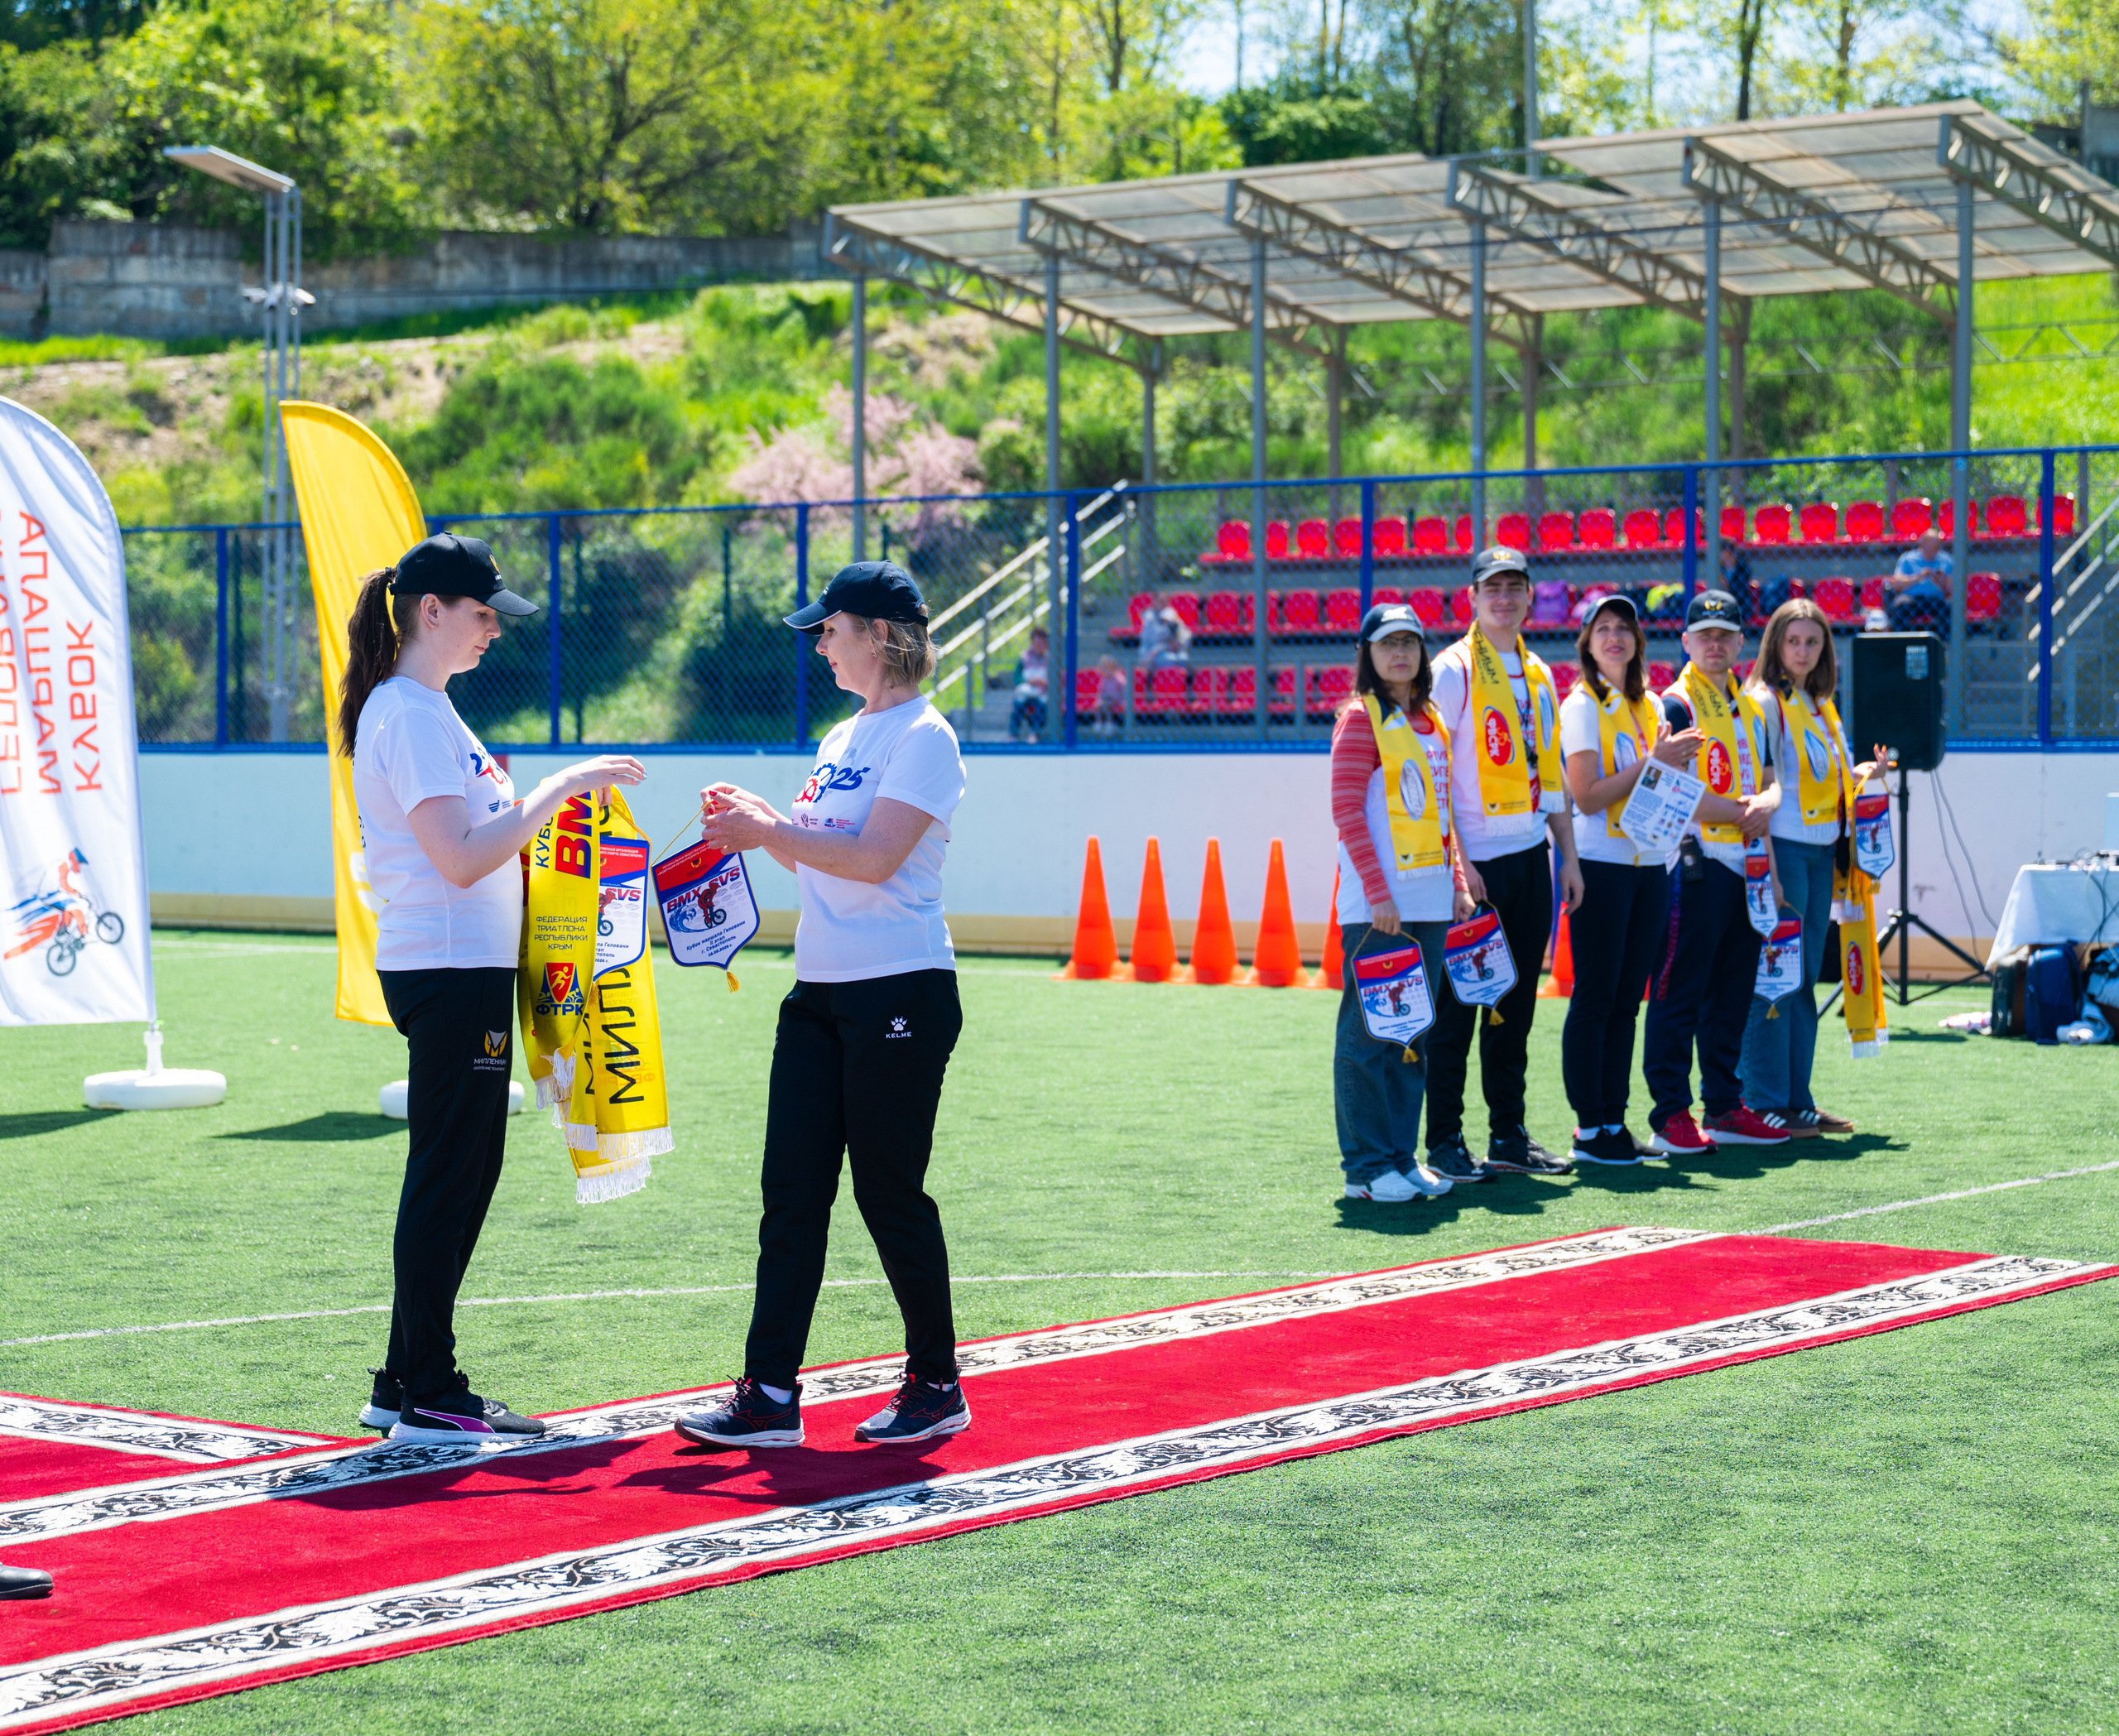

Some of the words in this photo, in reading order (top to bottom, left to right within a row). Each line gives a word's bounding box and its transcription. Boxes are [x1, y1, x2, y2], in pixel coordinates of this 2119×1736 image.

[667, 886, 702, 913] BMX
[686, 941, 701, 951] Кубок
[702, 932, 723, 944] маршала
[723, 921, 745, 934] Геловани
[706, 936, 736, 951] Севастополь
[536, 1004, 584, 1016] ФТРК
